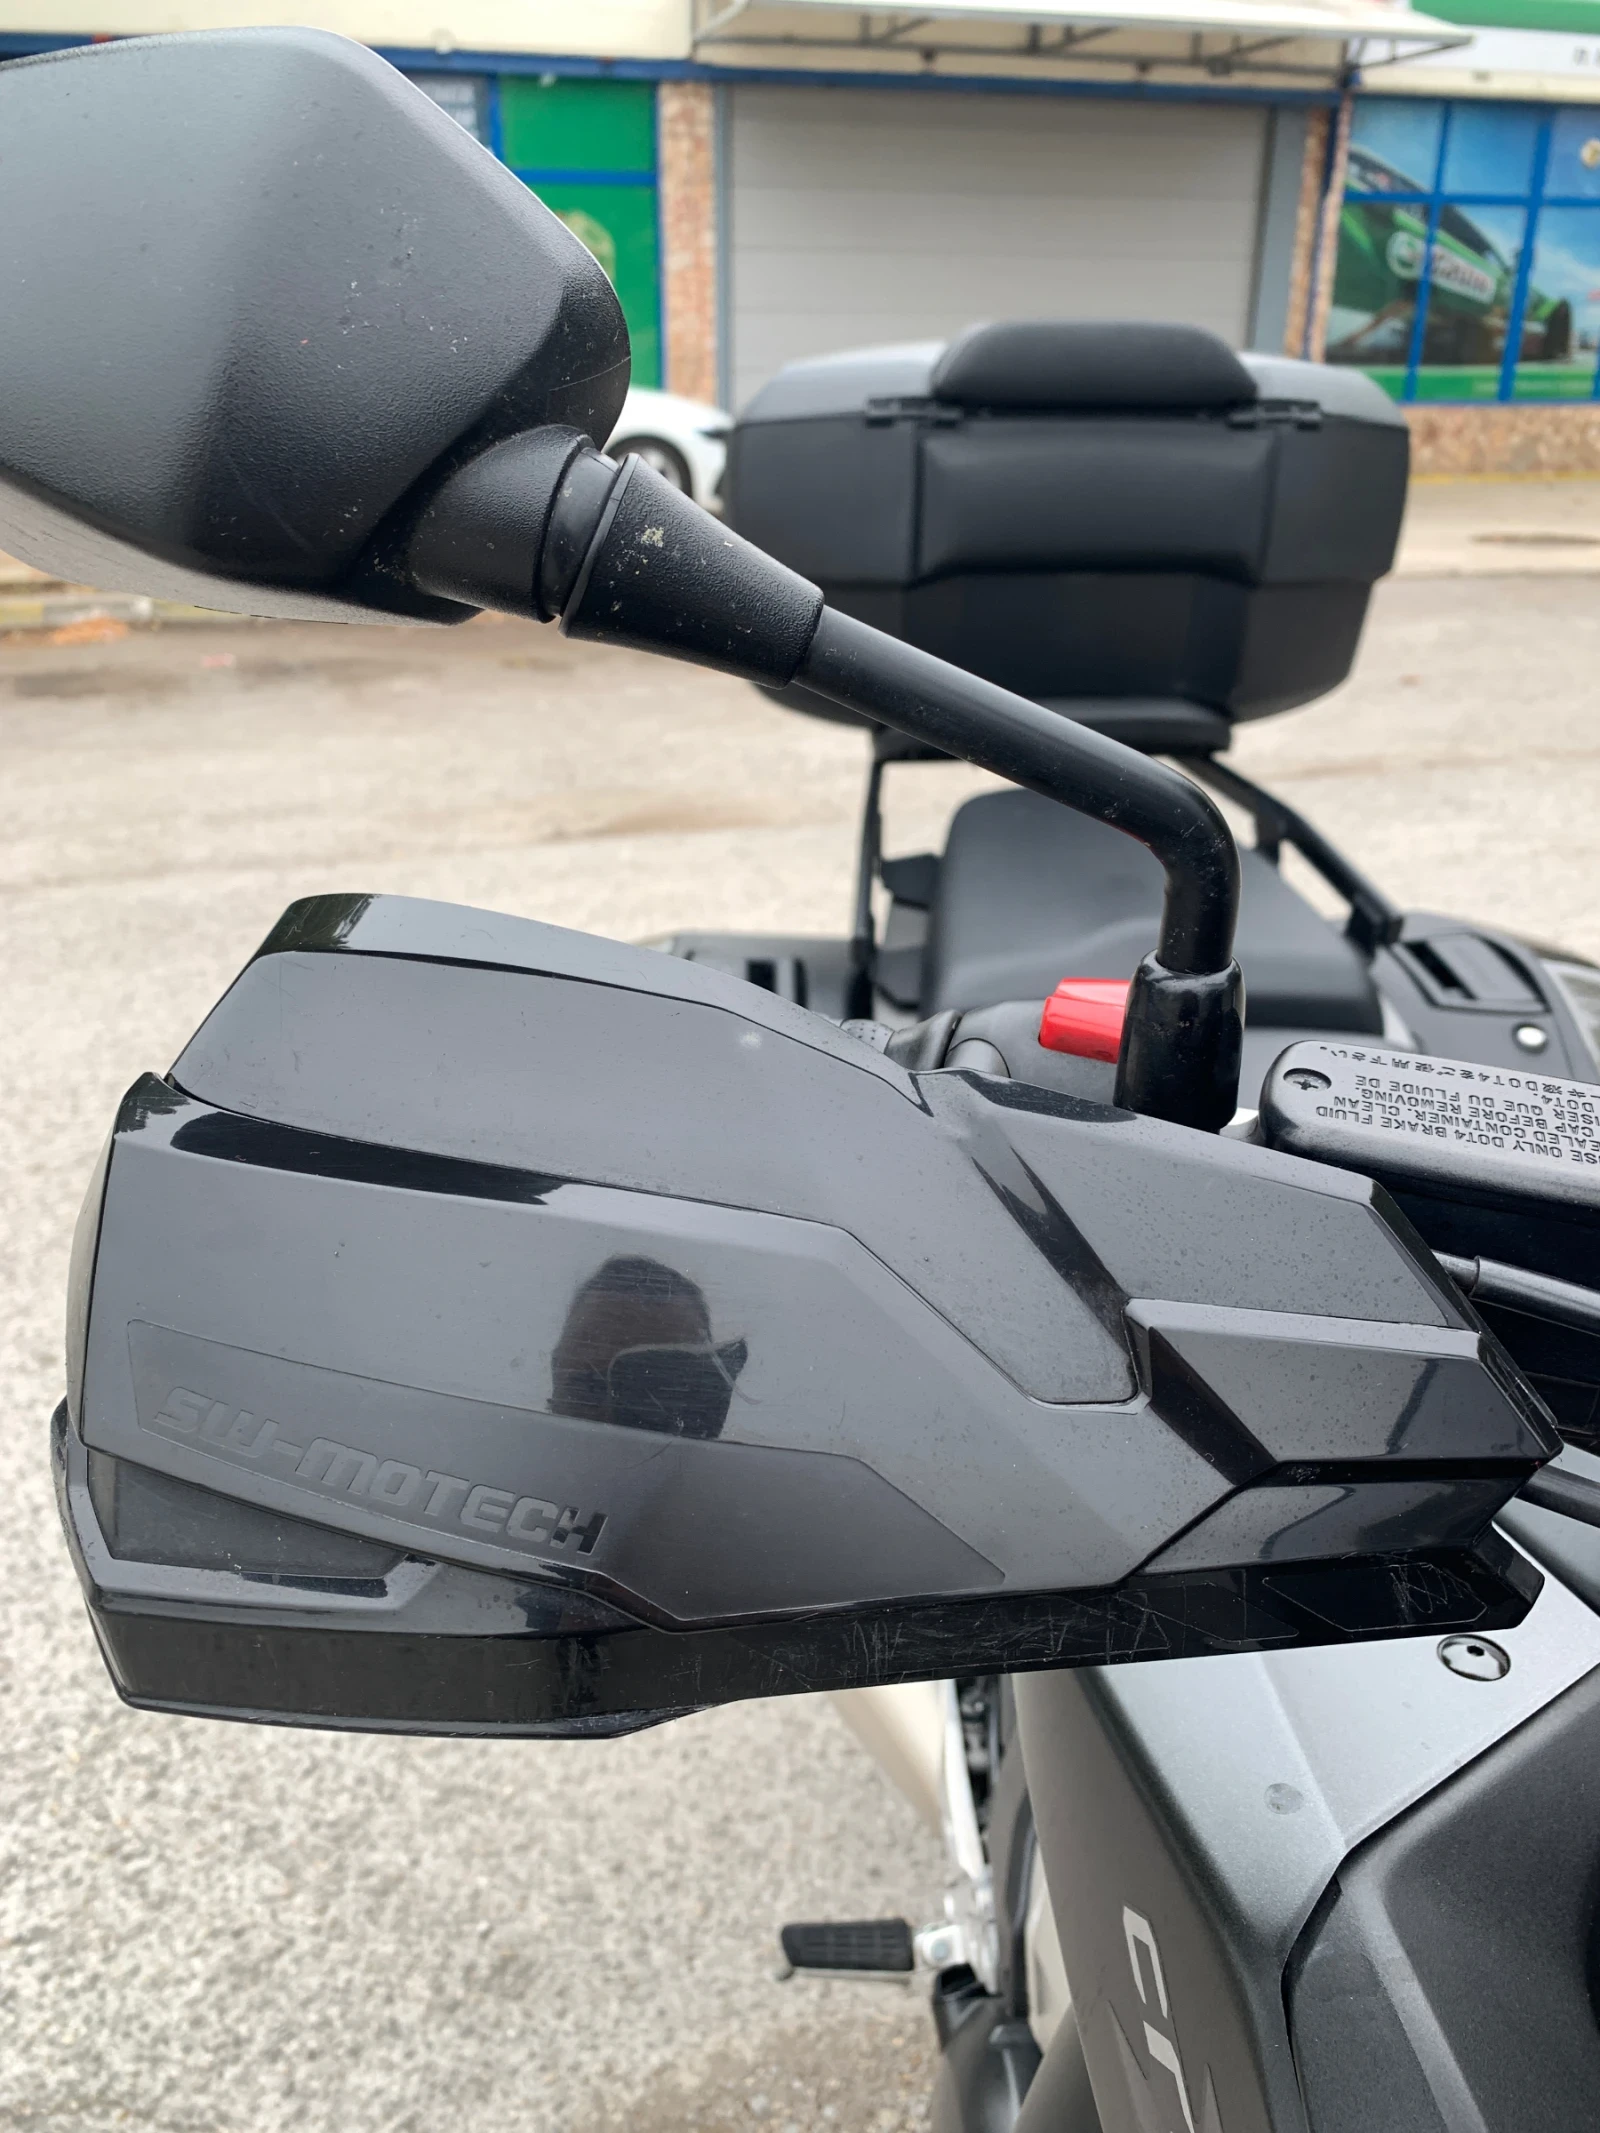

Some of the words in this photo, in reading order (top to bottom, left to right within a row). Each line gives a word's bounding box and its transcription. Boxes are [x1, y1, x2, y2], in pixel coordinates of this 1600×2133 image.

[1355, 1075, 1380, 1088] DE
[1355, 1087, 1461, 1114] REMOVING.
[1389, 1081, 1460, 1102] FLUIDE
[1334, 1096, 1400, 1116] CLEAN
[1468, 1095, 1494, 1108] DU
[1503, 1100, 1543, 1116] QUE
[1533, 1094, 1594, 1113] DOT4.
[1316, 1106, 1372, 1125] FLUID
[1408, 1108, 1526, 1138] CONTAINER.
[1468, 1106, 1547, 1129] BEFORE
[1380, 1117, 1447, 1138] BRAKE
[1555, 1122, 1594, 1137] CAP
[1454, 1130, 1504, 1148] DOT4
[1513, 1140, 1562, 1158] ONLY
[152, 1386, 609, 1555] SW-MOTECH
